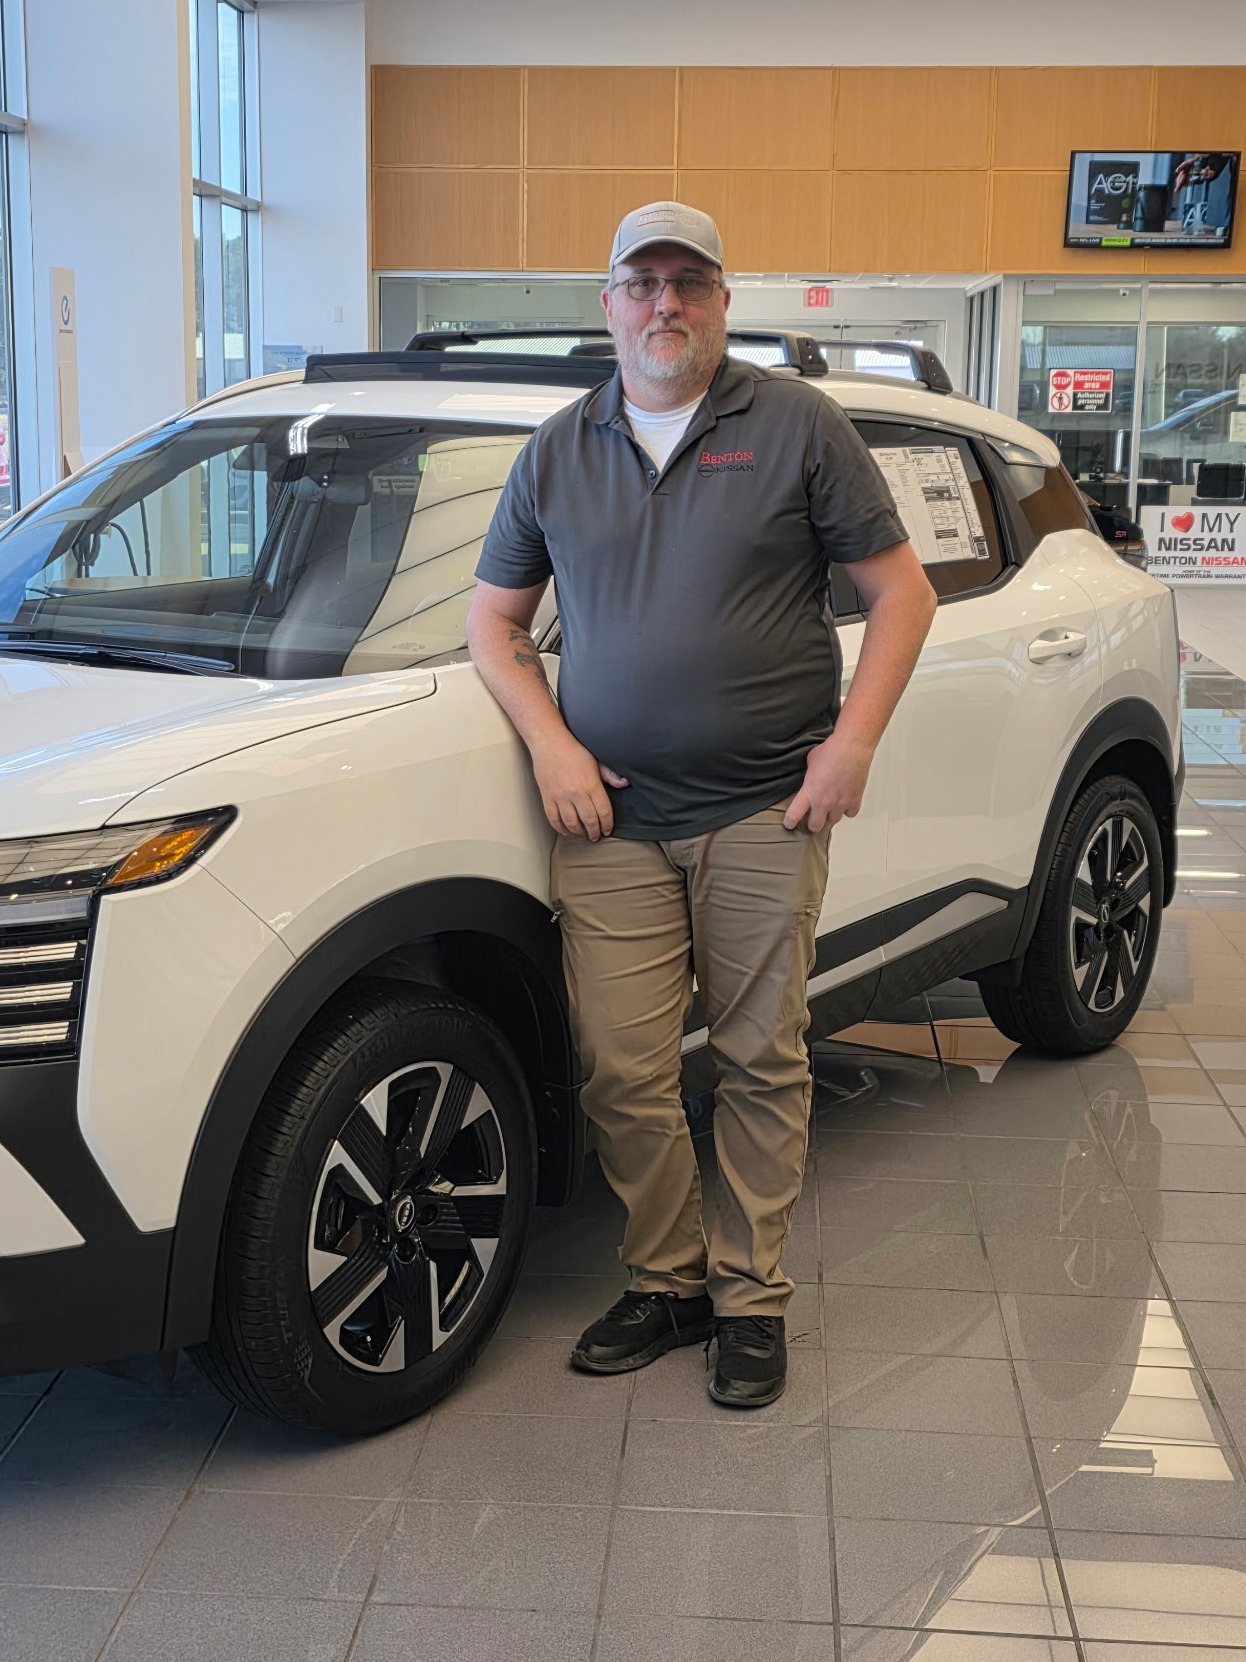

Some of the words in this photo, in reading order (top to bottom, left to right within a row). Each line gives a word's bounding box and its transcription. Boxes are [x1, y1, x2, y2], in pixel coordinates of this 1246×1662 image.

[807, 288, 830, 307] EXIT
[1052, 376, 1072, 385] STOP
[1075, 373, 1111, 381] Restricted
[699, 451, 753, 464] BENTON
[716, 464, 754, 473] NISSAN
[1160, 512, 1165, 533] I
[1200, 512, 1241, 533] MY
[1158, 537, 1235, 551] NISSAN
